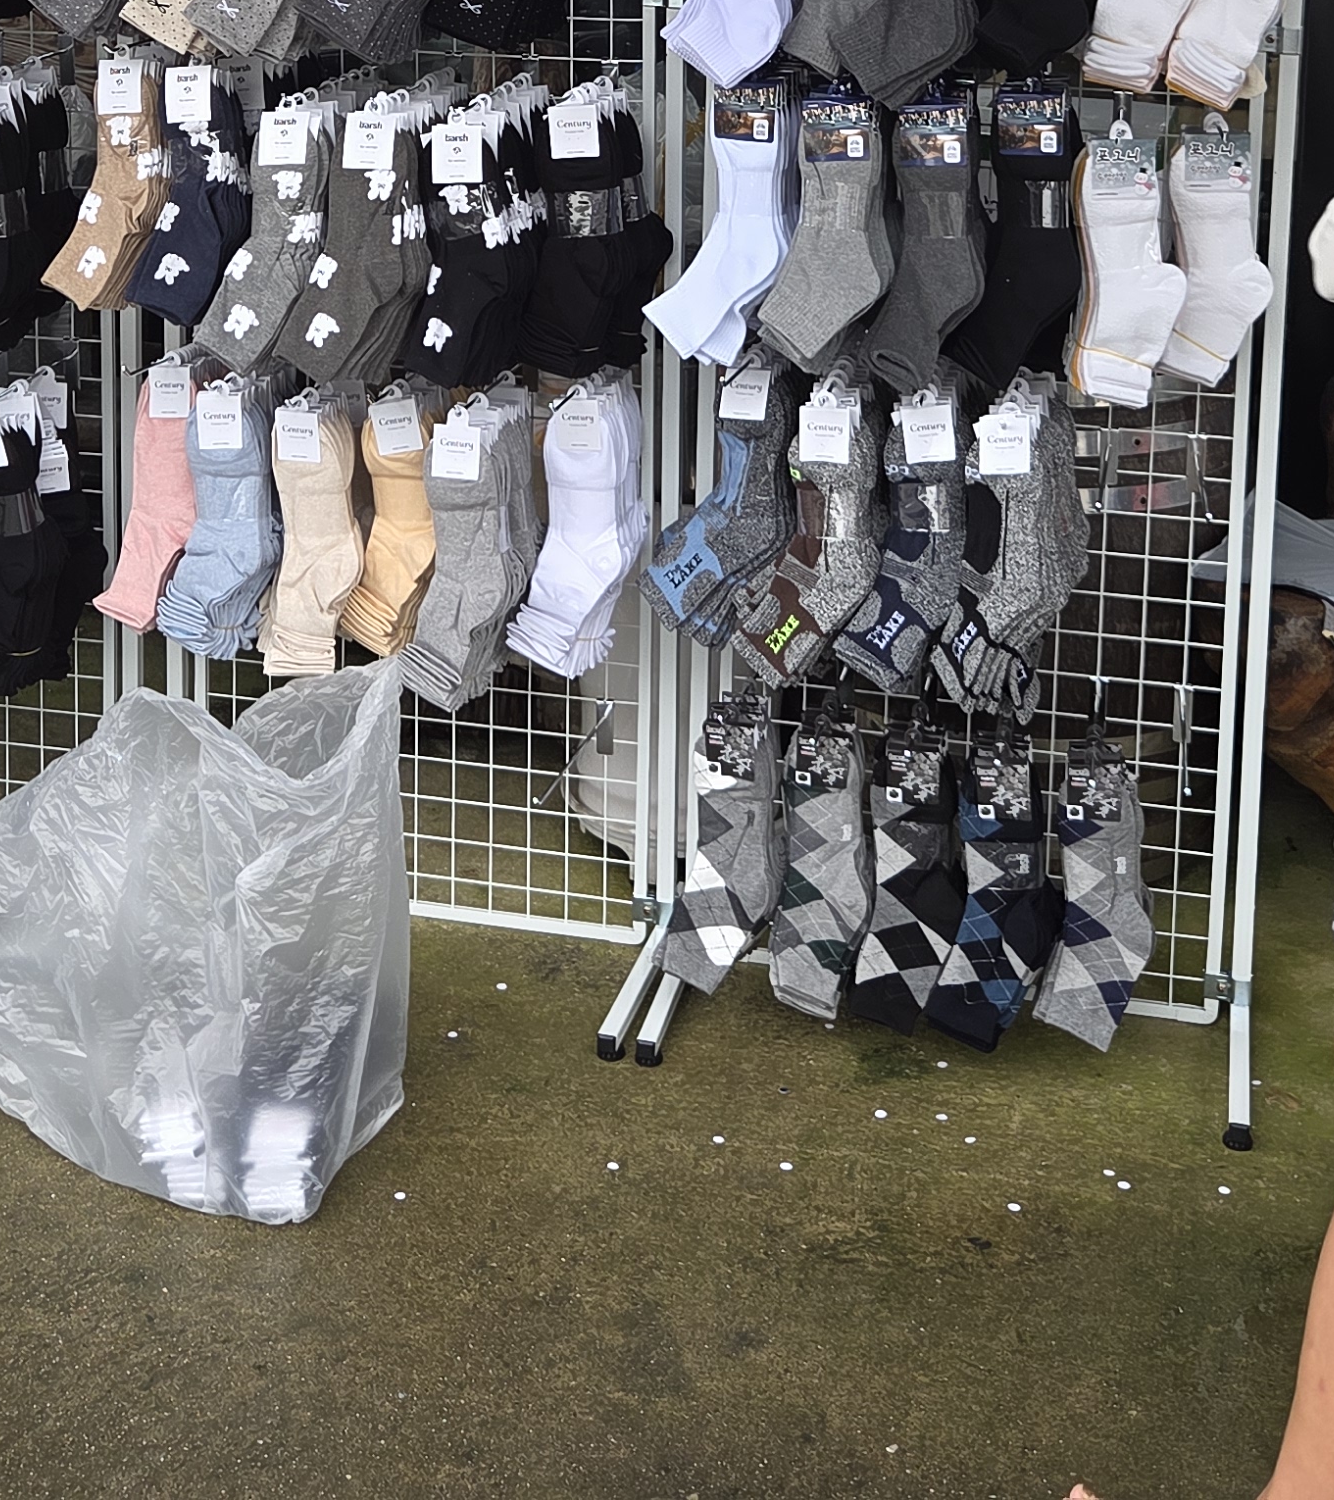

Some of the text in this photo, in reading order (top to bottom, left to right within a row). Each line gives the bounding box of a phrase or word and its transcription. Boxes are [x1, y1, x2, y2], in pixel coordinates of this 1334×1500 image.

[109, 66, 131, 76] barsh
[273, 118, 297, 127] barsh
[359, 120, 383, 130] barsh
[556, 118, 592, 130] Century
[444, 133, 469, 143] barsh
[154, 379, 186, 392] Century
[729, 381, 763, 393] Century
[203, 410, 236, 422] Century
[378, 414, 412, 428] Century
[560, 411, 595, 424] Century
[282, 424, 314, 437] Century
[807, 422, 844, 435] Century
[909, 421, 947, 433] Century
[440, 437, 474, 451] Century
[986, 434, 1024, 445] Century
[669, 553, 703, 589] LAKE
[769, 614, 800, 655] LAKE
[872, 610, 906, 650] LAKE
